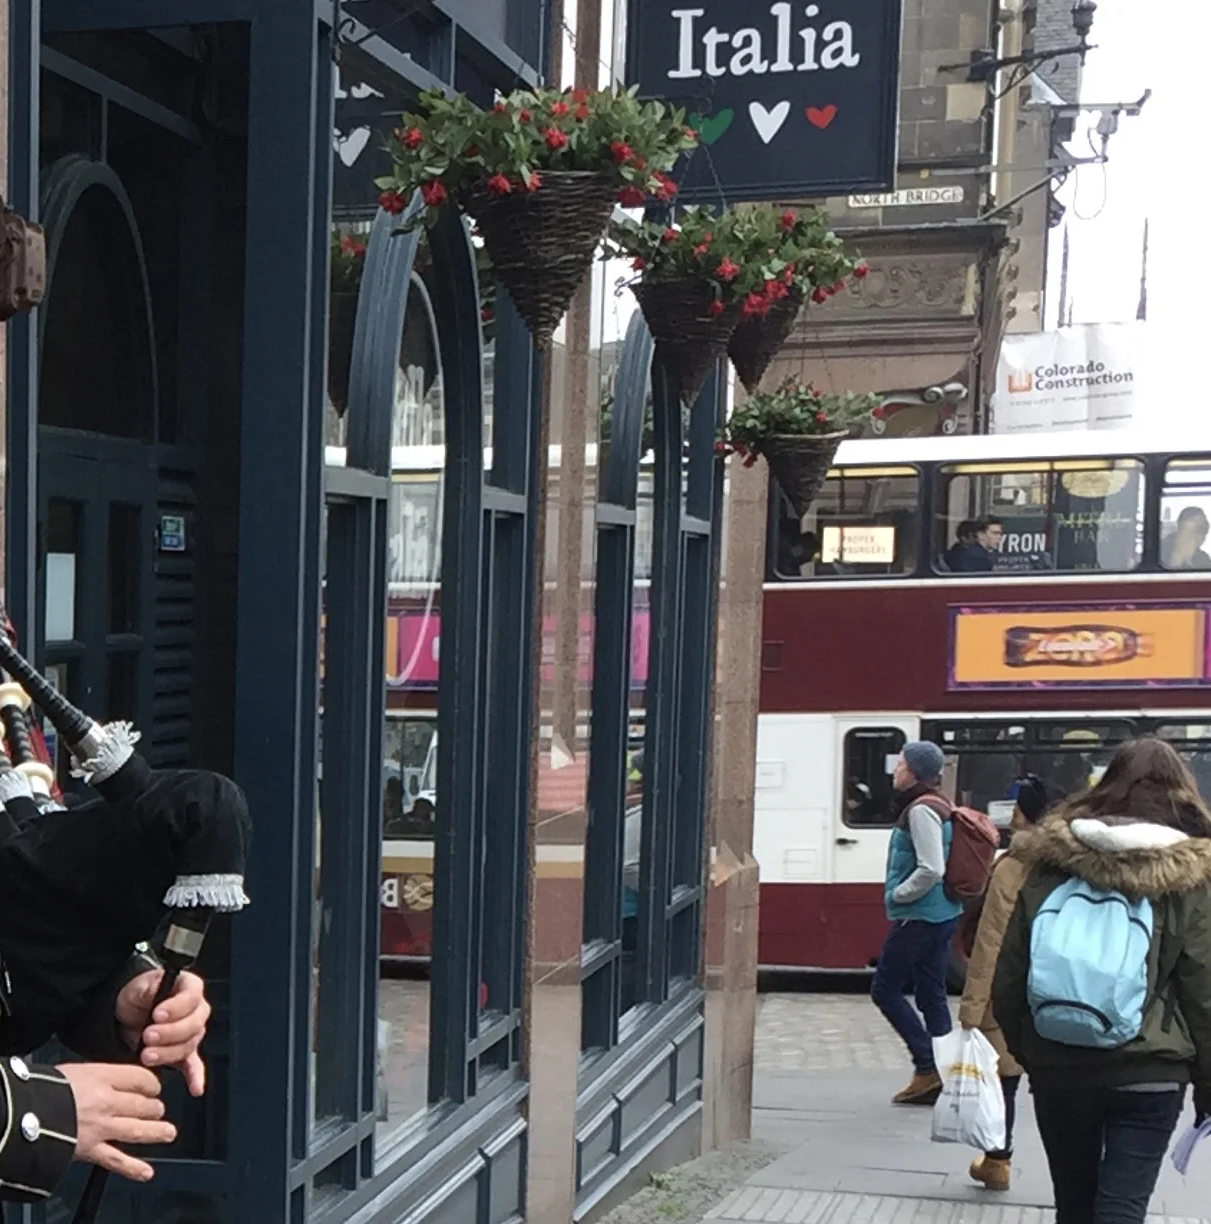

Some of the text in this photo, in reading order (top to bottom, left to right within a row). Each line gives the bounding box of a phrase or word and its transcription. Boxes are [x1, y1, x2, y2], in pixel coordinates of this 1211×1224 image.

[667, 2, 860, 78] Italia
[853, 188, 961, 206] NORTH BRIDGE
[1035, 360, 1105, 378] Colorado
[1035, 371, 1133, 391] Construction
[997, 533, 1047, 553] YRON
